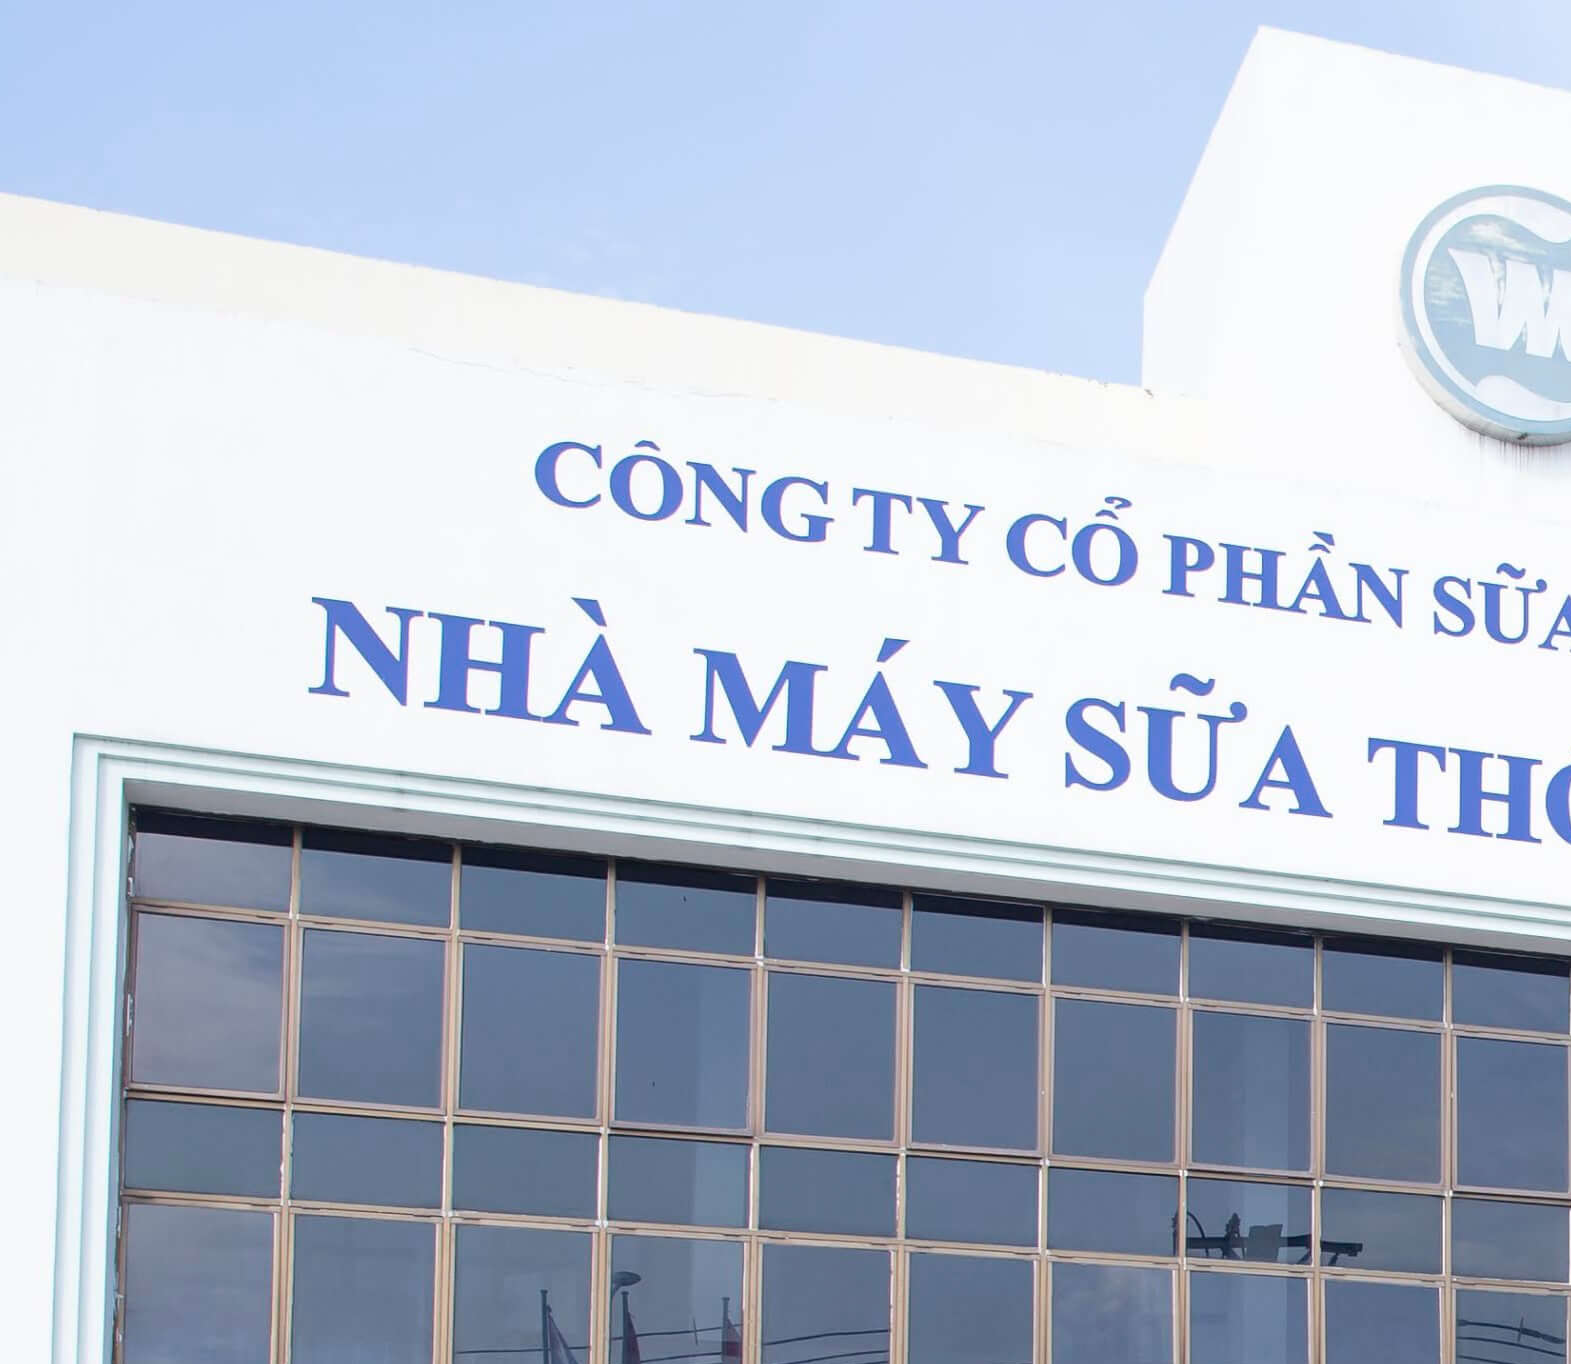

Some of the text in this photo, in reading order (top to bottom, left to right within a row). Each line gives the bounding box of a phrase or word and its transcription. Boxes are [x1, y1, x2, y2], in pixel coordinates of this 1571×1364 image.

[533, 438, 833, 542] CÔNG
[852, 488, 984, 563] TY
[1005, 496, 1138, 585] CỔ
[1163, 531, 1407, 624] PHẦN
[307, 597, 650, 734] NHÀ
[690, 638, 1032, 778] MÁY
[1064, 673, 1332, 817] SỮA
